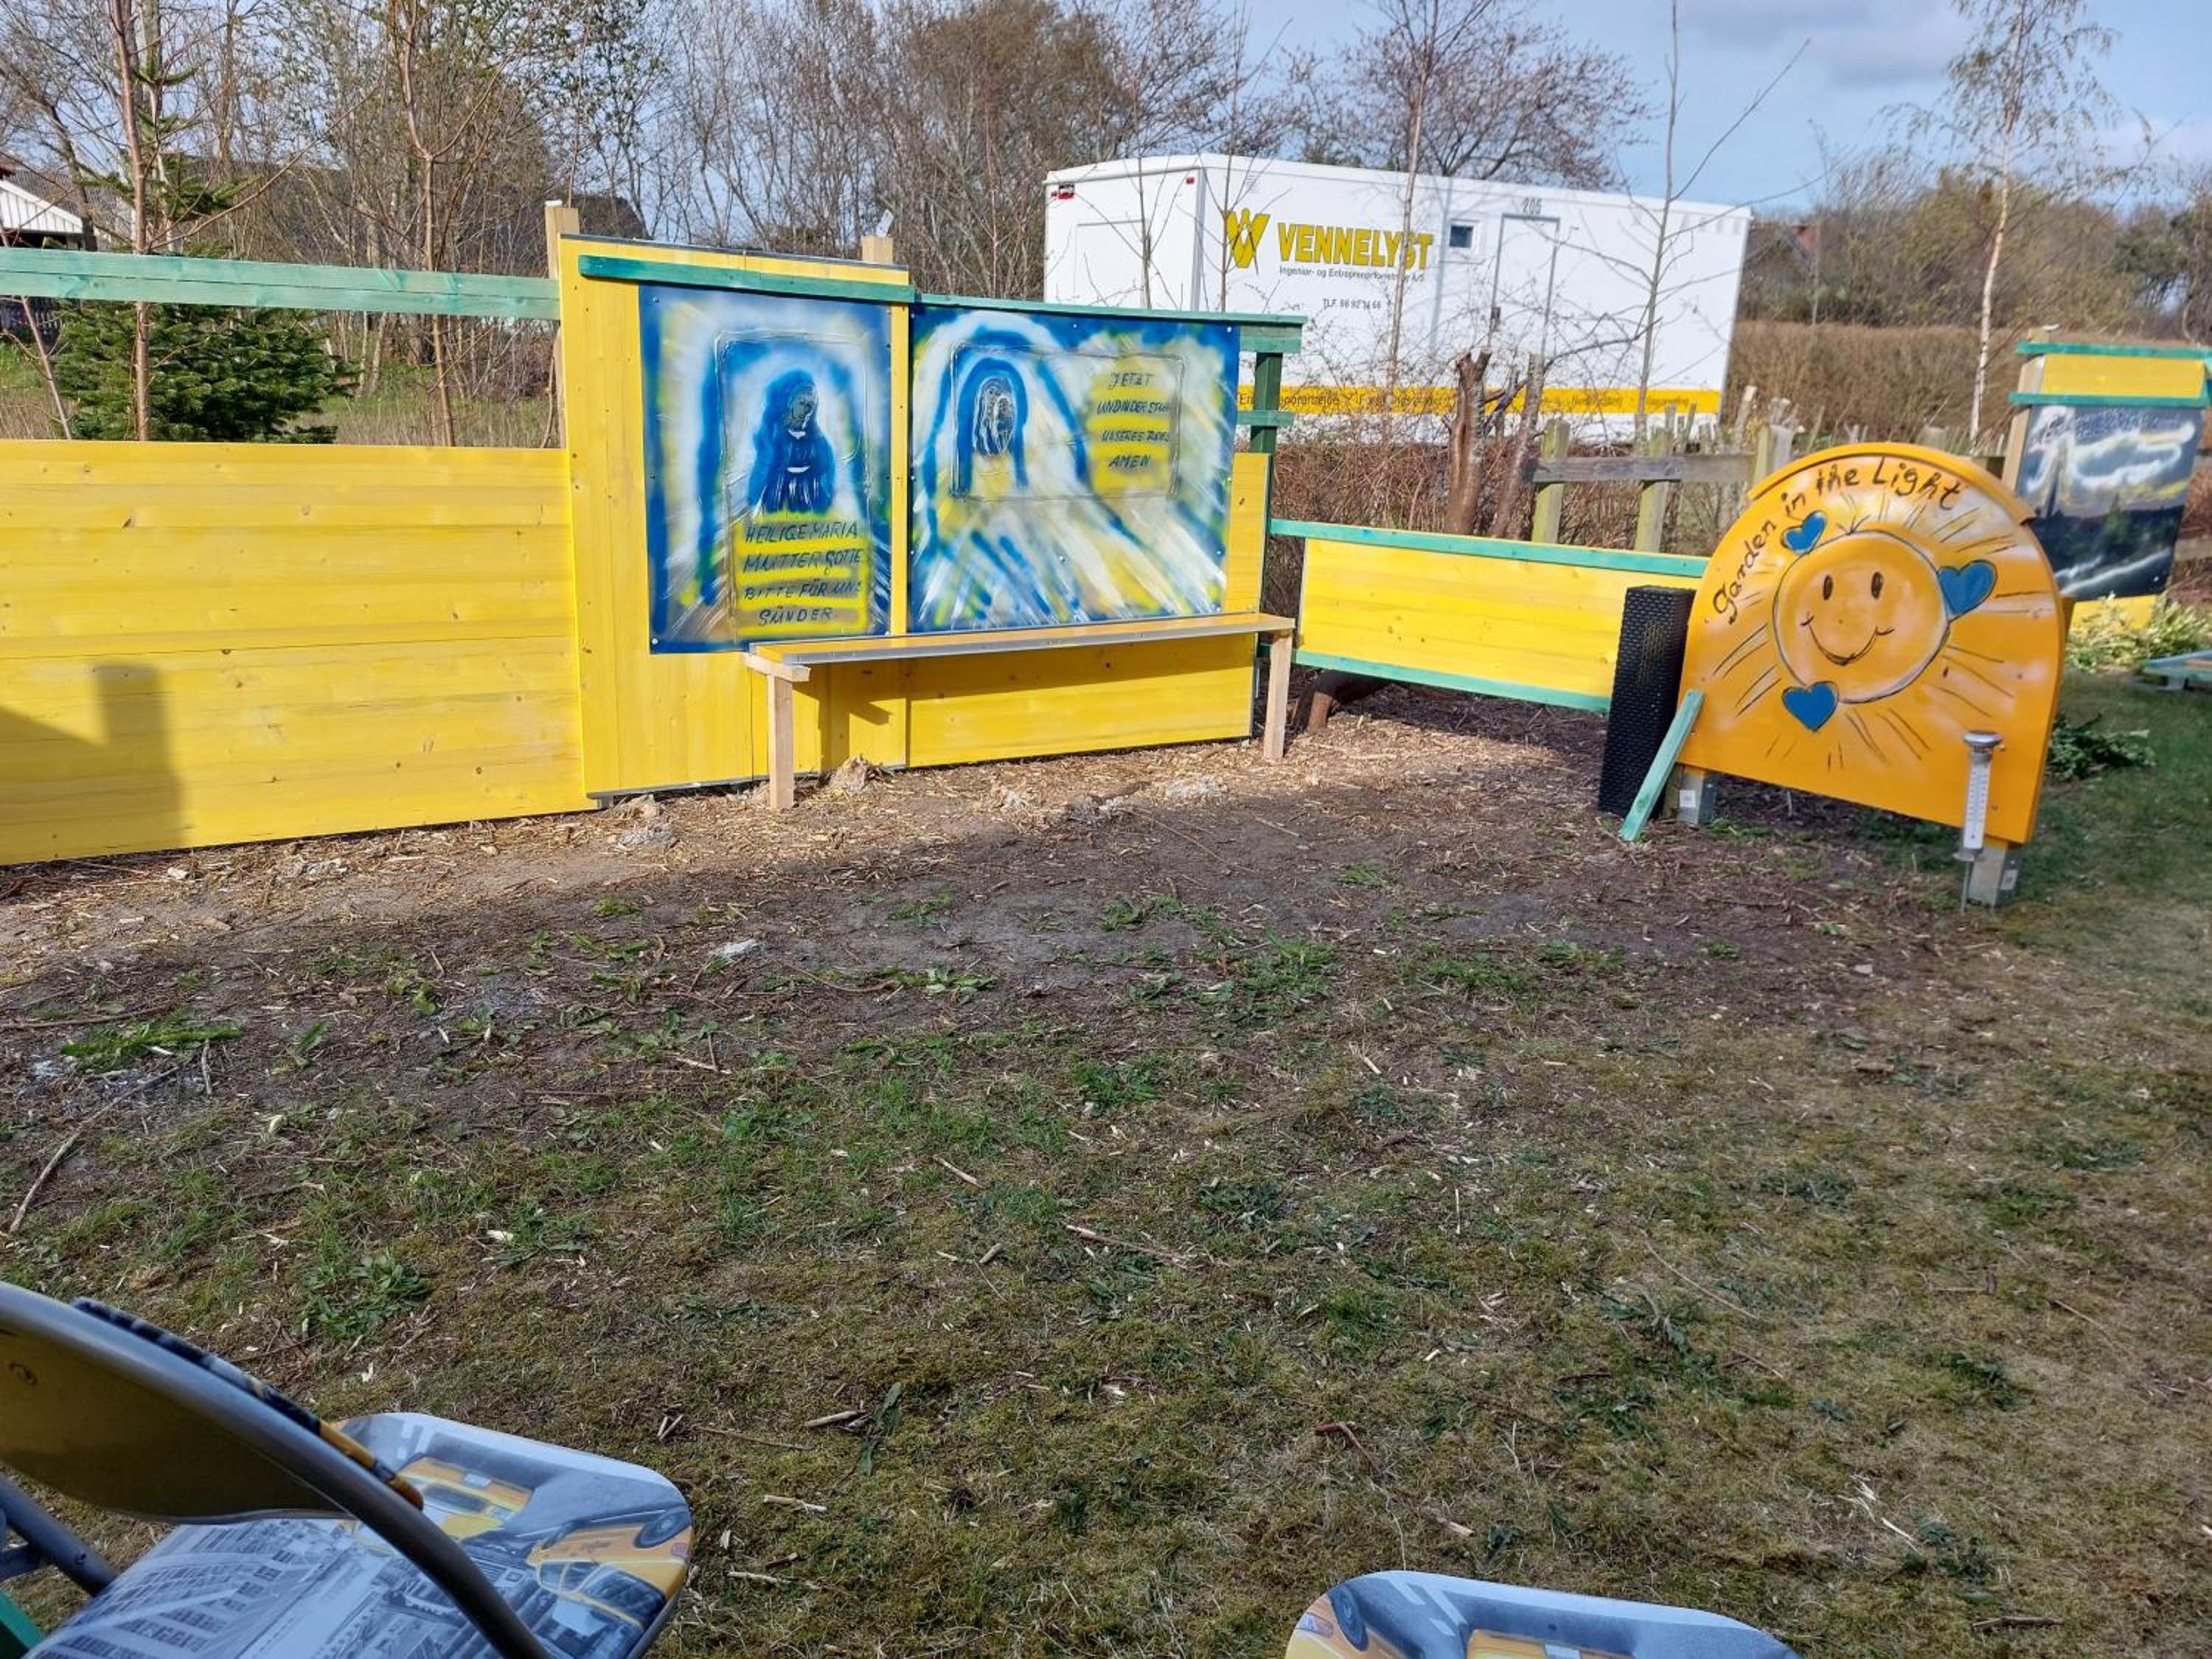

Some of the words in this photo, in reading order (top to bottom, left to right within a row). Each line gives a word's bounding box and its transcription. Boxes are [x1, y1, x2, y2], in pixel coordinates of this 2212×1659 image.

[1522, 197, 1543, 215] 205
[1278, 222, 1433, 270] VENNELYST
[1108, 455, 1152, 468] AMEN
[1781, 491, 1806, 516] in
[1815, 462, 1861, 497] the
[1871, 455, 1965, 510] Light
[745, 524, 808, 543] HEILIGE
[810, 521, 858, 540] MARIA
[743, 552, 821, 574] MUTTER
[744, 585, 795, 599] BITTE
[799, 578, 827, 597] FÜR
[758, 606, 833, 627] SÜNDER
